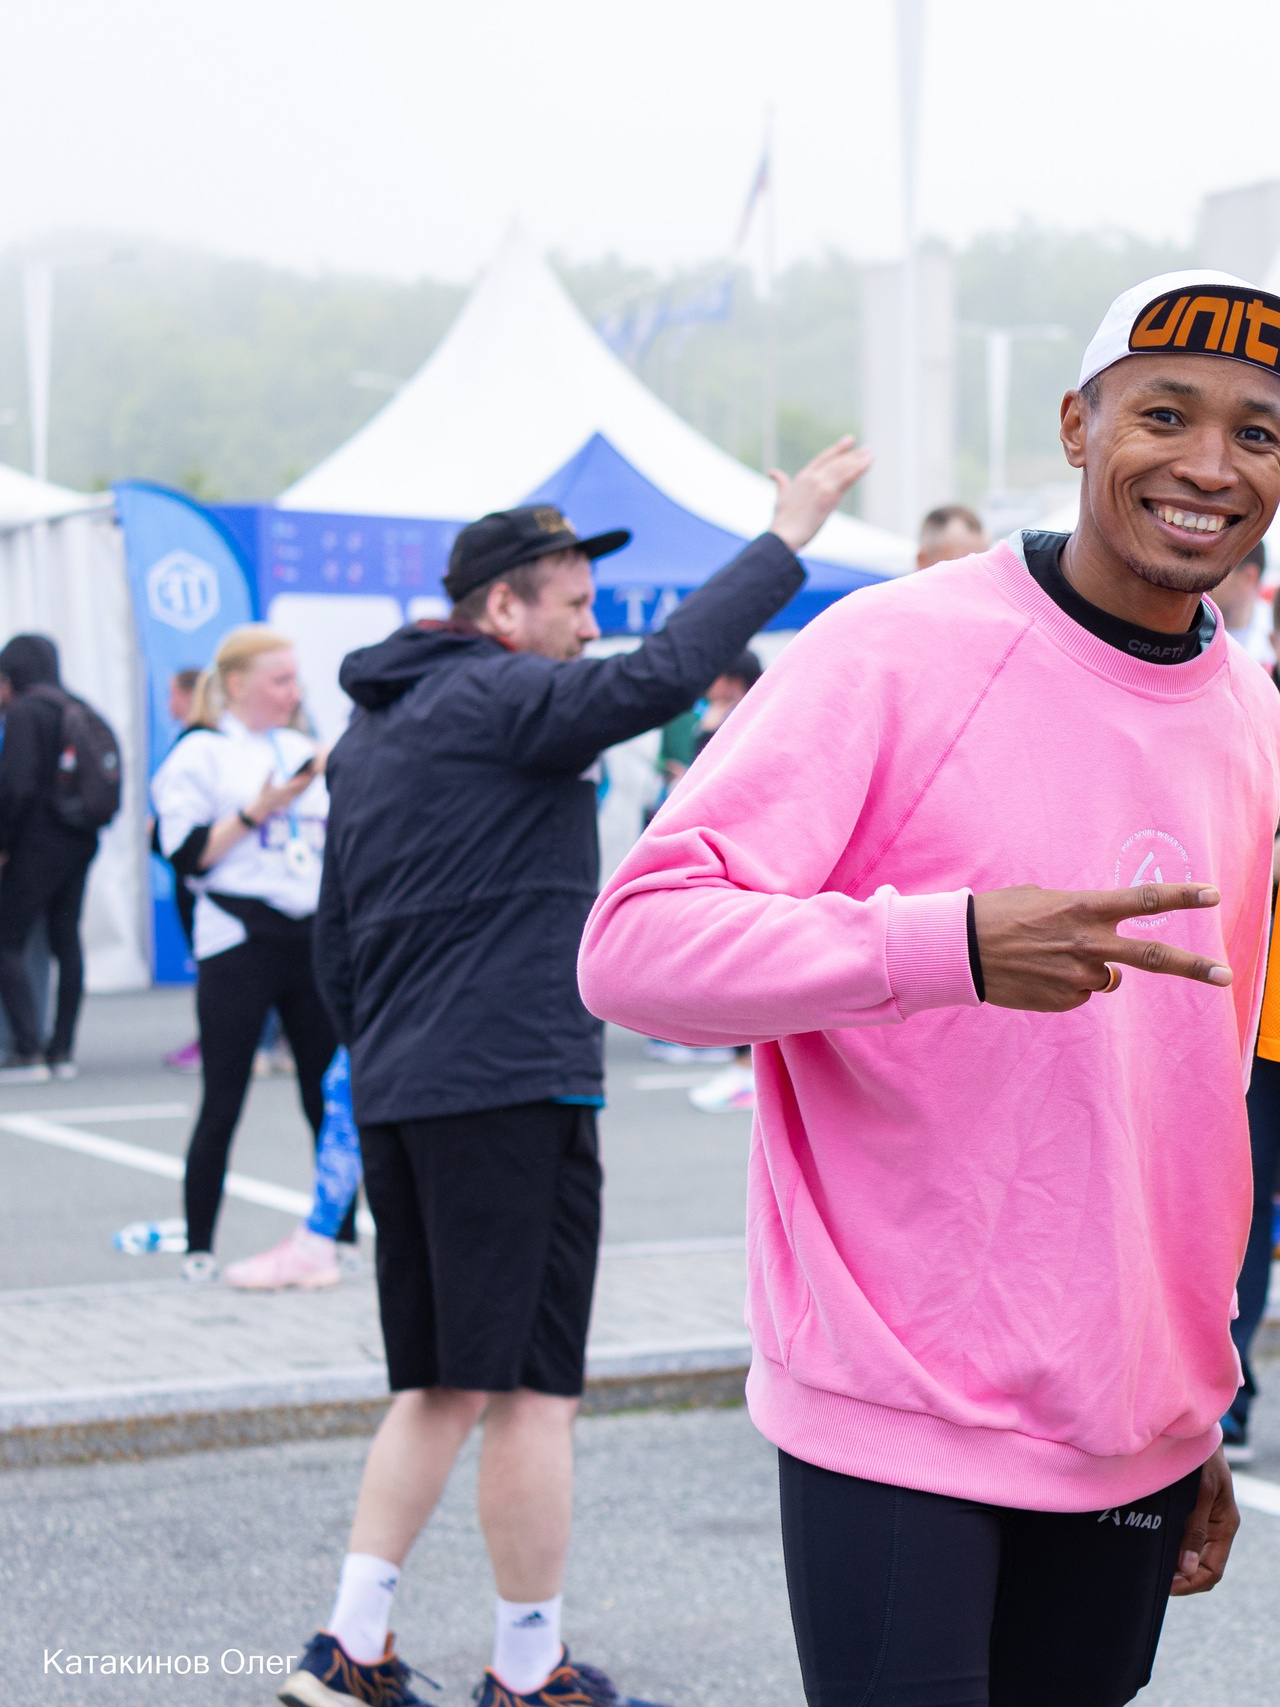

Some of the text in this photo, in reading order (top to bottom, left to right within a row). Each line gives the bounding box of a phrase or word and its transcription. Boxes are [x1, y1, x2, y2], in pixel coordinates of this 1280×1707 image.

[1127, 639, 1180, 660] CRAFT
[1134, 829, 1156, 840] SPORT
[1157, 830, 1179, 847] WEAR
[1124, 1511, 1162, 1529] MAD
